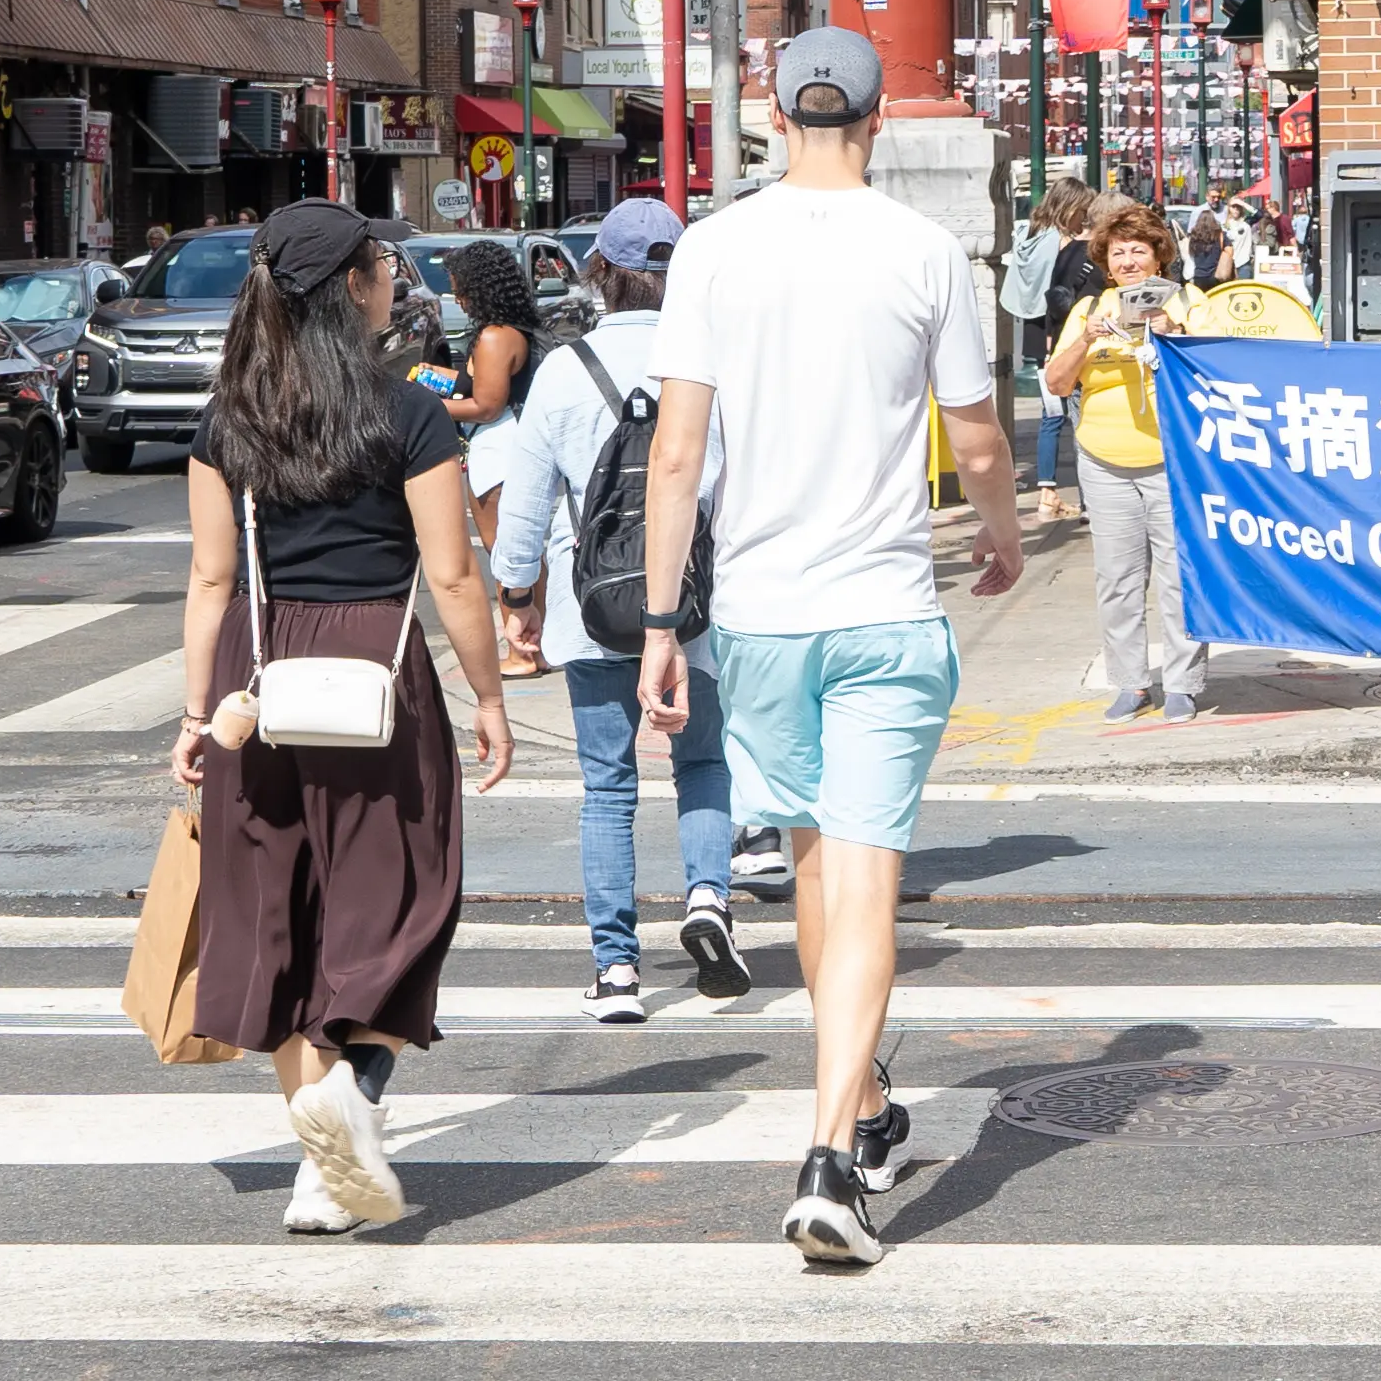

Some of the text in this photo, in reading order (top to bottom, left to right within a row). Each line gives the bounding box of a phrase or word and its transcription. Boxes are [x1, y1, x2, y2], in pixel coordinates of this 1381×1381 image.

[586, 60, 609, 74] Local
[611, 58, 640, 77] Yogurt
[642, 59, 663, 73] Fres
[1221, 324, 1279, 336] UNGRY
[1200, 492, 1356, 567] Forced
